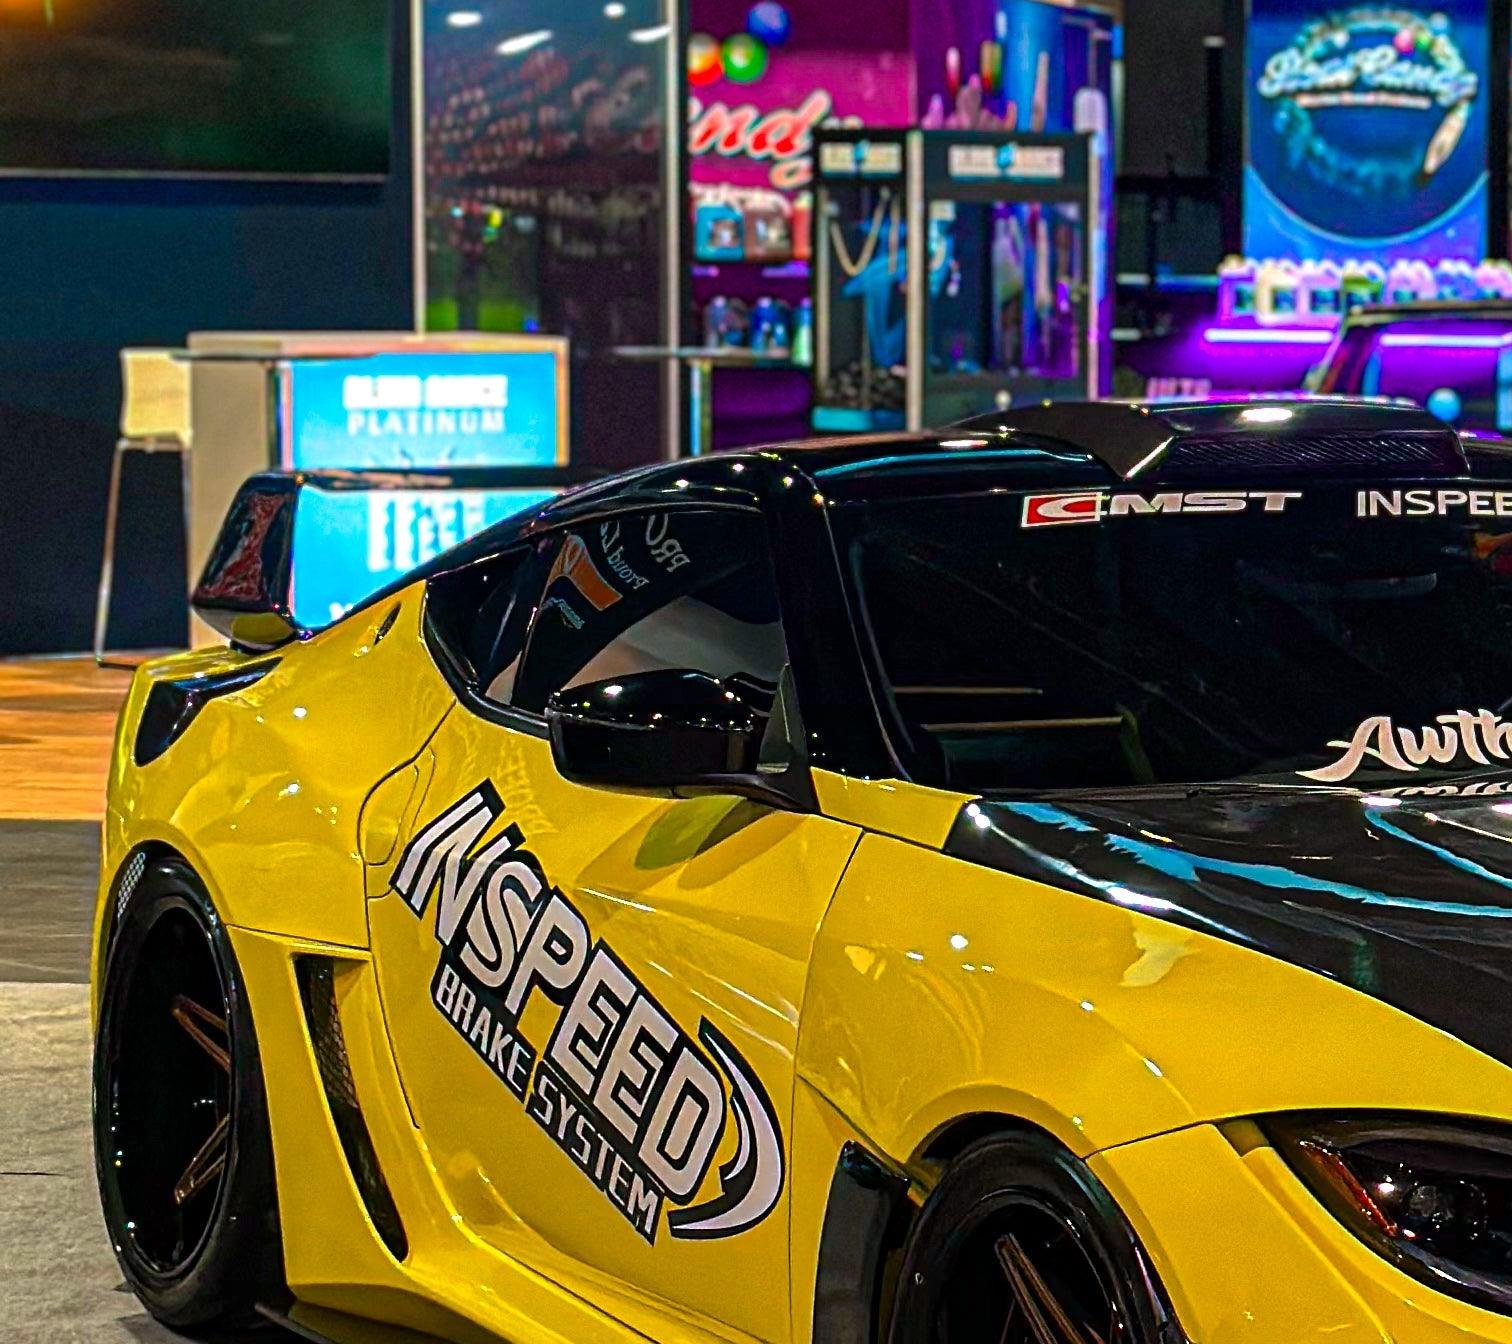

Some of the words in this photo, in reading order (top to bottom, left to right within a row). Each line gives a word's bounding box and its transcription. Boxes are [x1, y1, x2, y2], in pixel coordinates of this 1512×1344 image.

[347, 410, 505, 436] PLATINUM
[1021, 492, 1302, 528] CMST
[395, 786, 724, 1201] INSPEED
[436, 963, 533, 1096] BRAKE
[531, 1075, 660, 1237] SYSTEM
